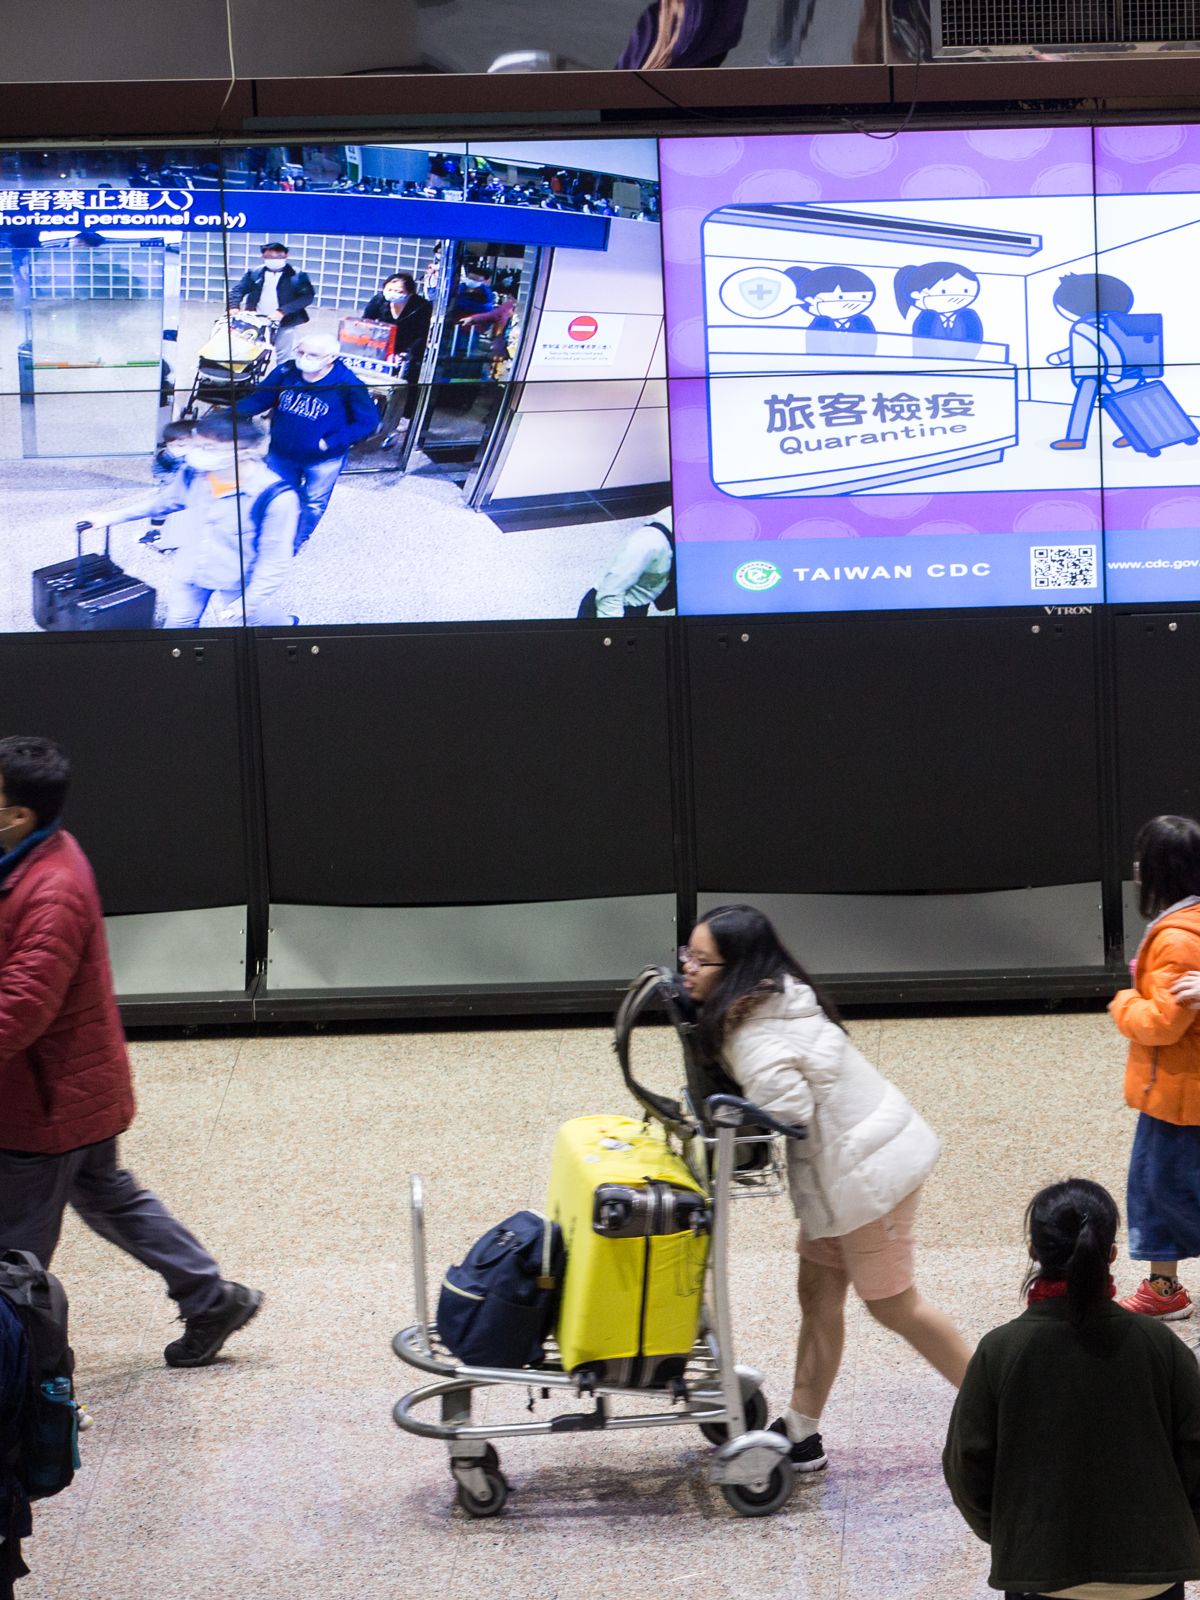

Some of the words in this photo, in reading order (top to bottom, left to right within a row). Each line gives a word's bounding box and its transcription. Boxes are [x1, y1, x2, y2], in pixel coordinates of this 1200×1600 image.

[84, 212, 190, 228] personnel
[194, 213, 247, 228] only)
[765, 390, 976, 435] 旅客檢疫
[778, 423, 968, 456] Quarantine
[793, 566, 912, 582] TAIWAN
[926, 562, 991, 577] CDC
[1043, 606, 1093, 616] VTRON
